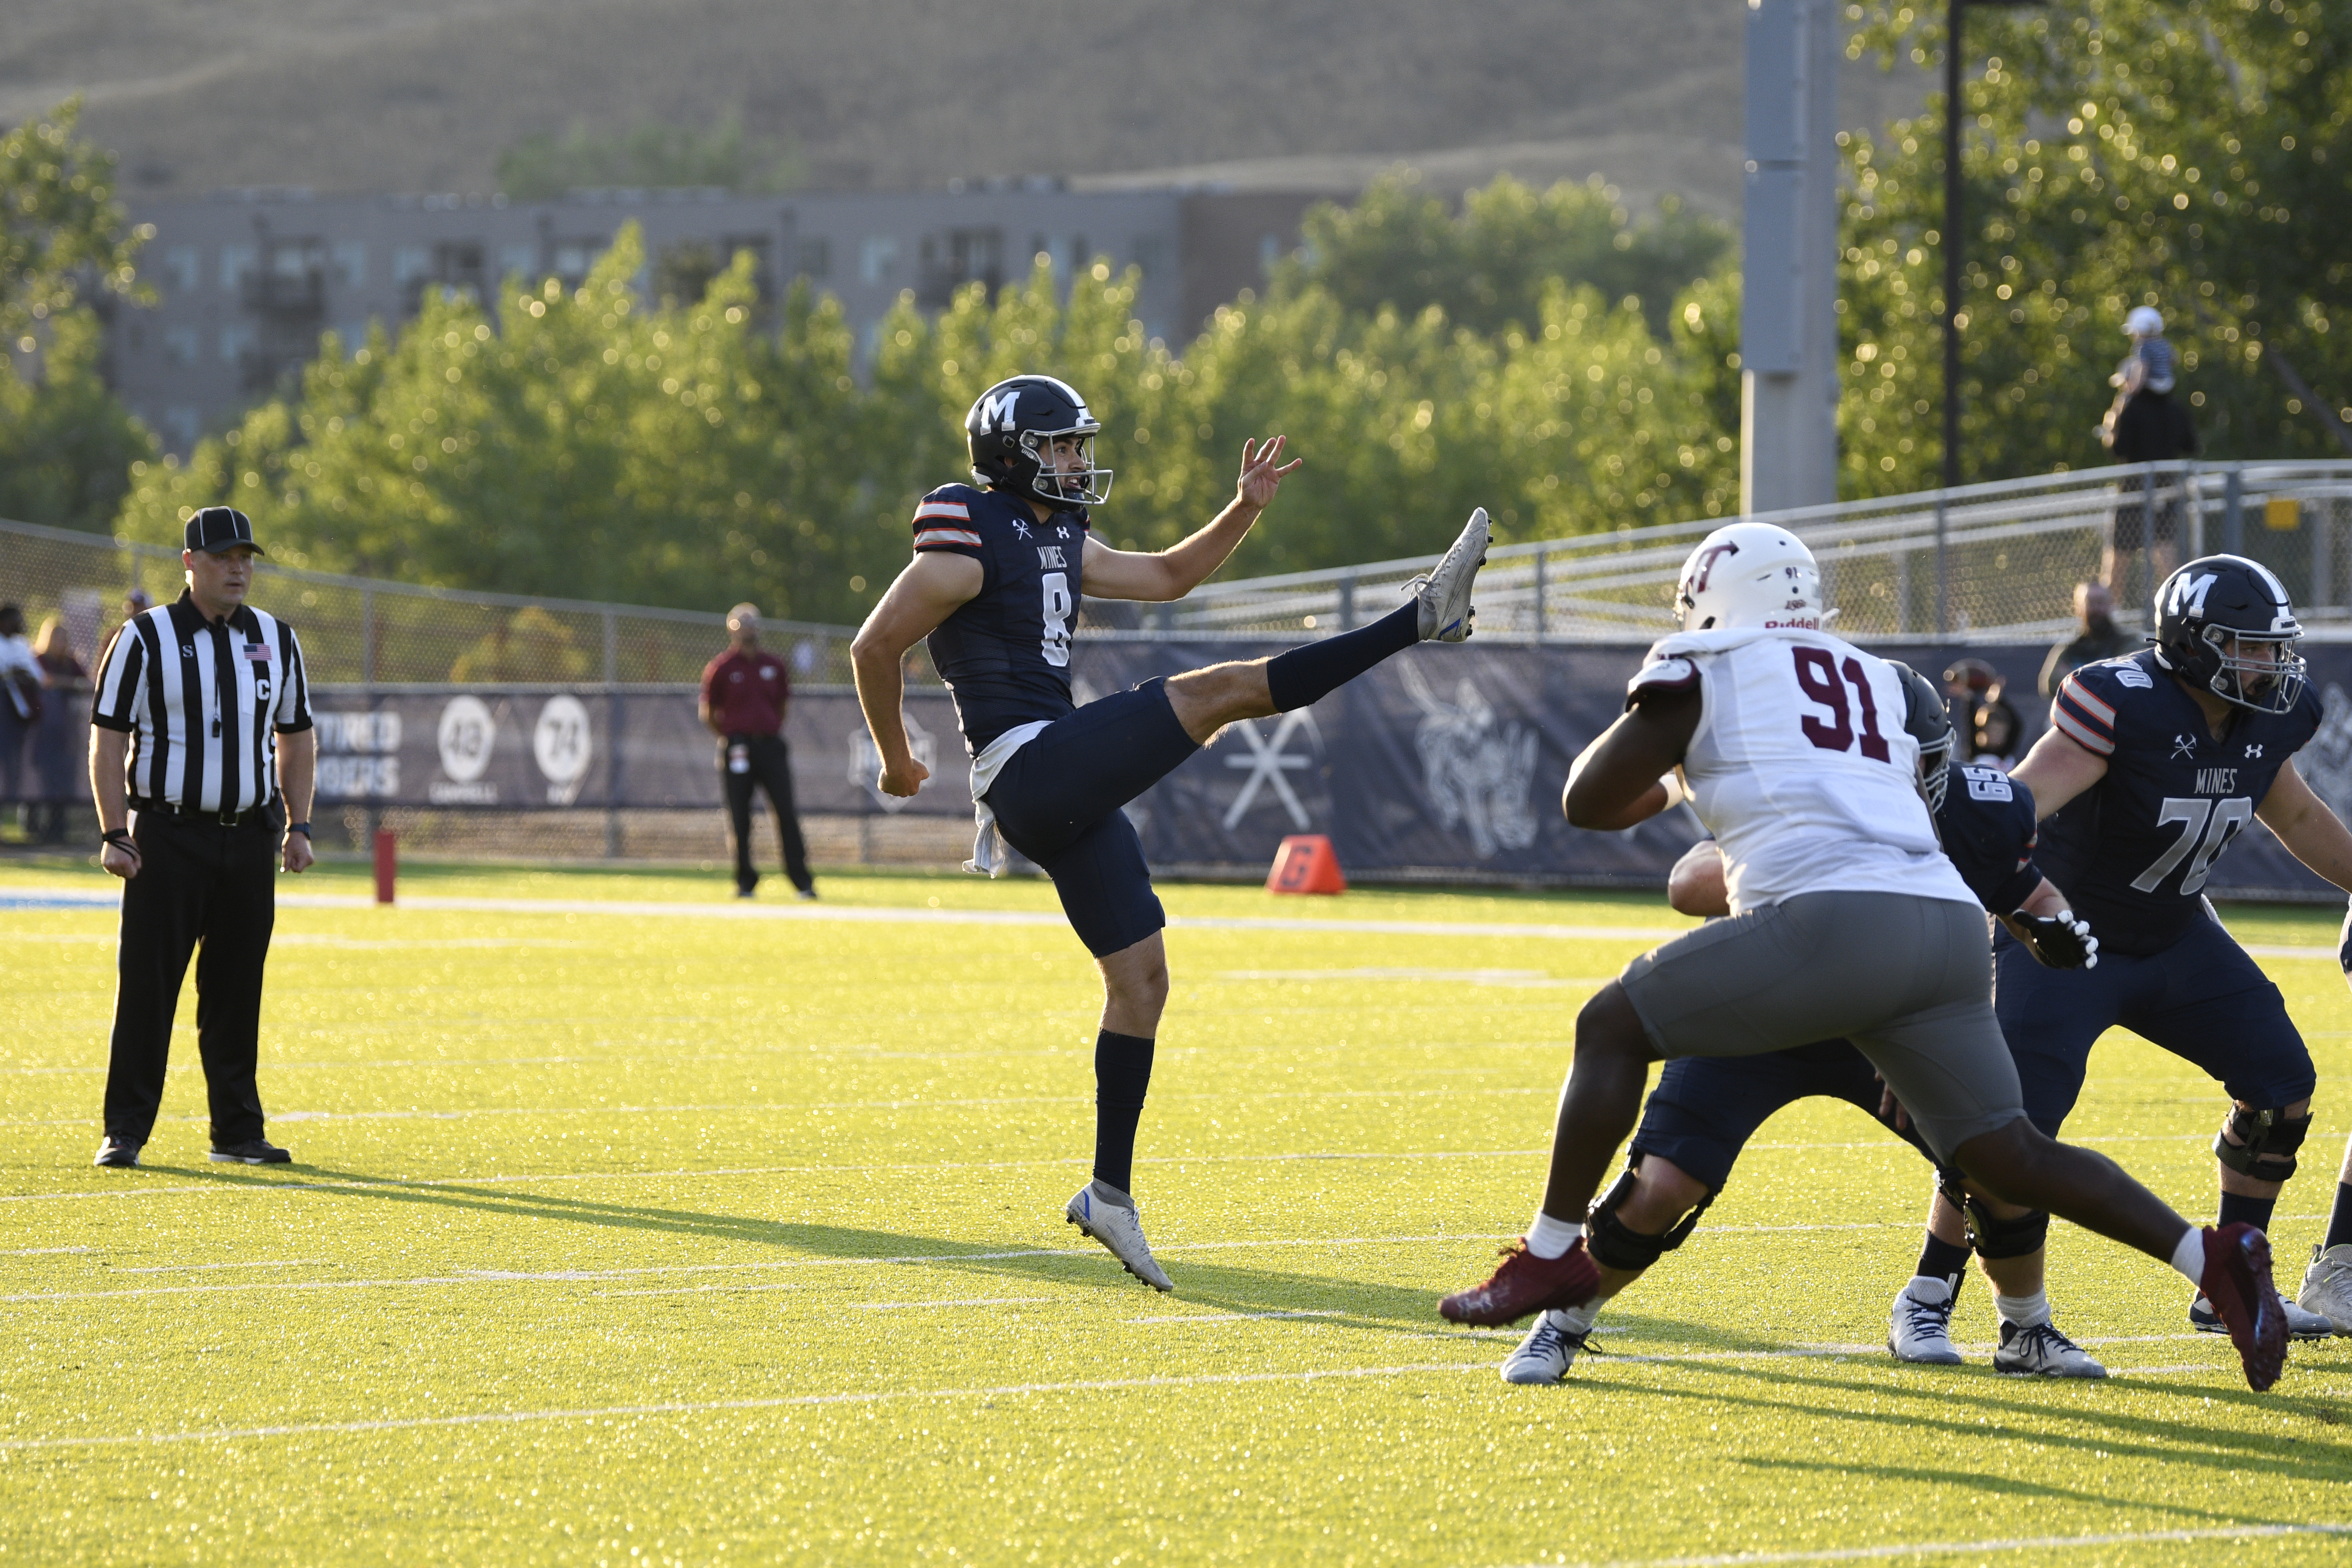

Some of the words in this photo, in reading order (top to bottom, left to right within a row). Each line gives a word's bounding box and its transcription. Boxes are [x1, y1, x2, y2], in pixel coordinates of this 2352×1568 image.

[980, 391, 1021, 436] M
[1037, 546, 1067, 569] MINES
[1786, 567, 1799, 579] 91
[2167, 572, 2218, 618] M
[1041, 572, 1071, 667] 8
[182, 645, 193, 658] S
[2102, 659, 2153, 689] 70
[256, 679, 270, 701] C
[1791, 646, 1891, 764] 91
[2194, 768, 2238, 794] MINES
[2130, 796, 2252, 896] 70
